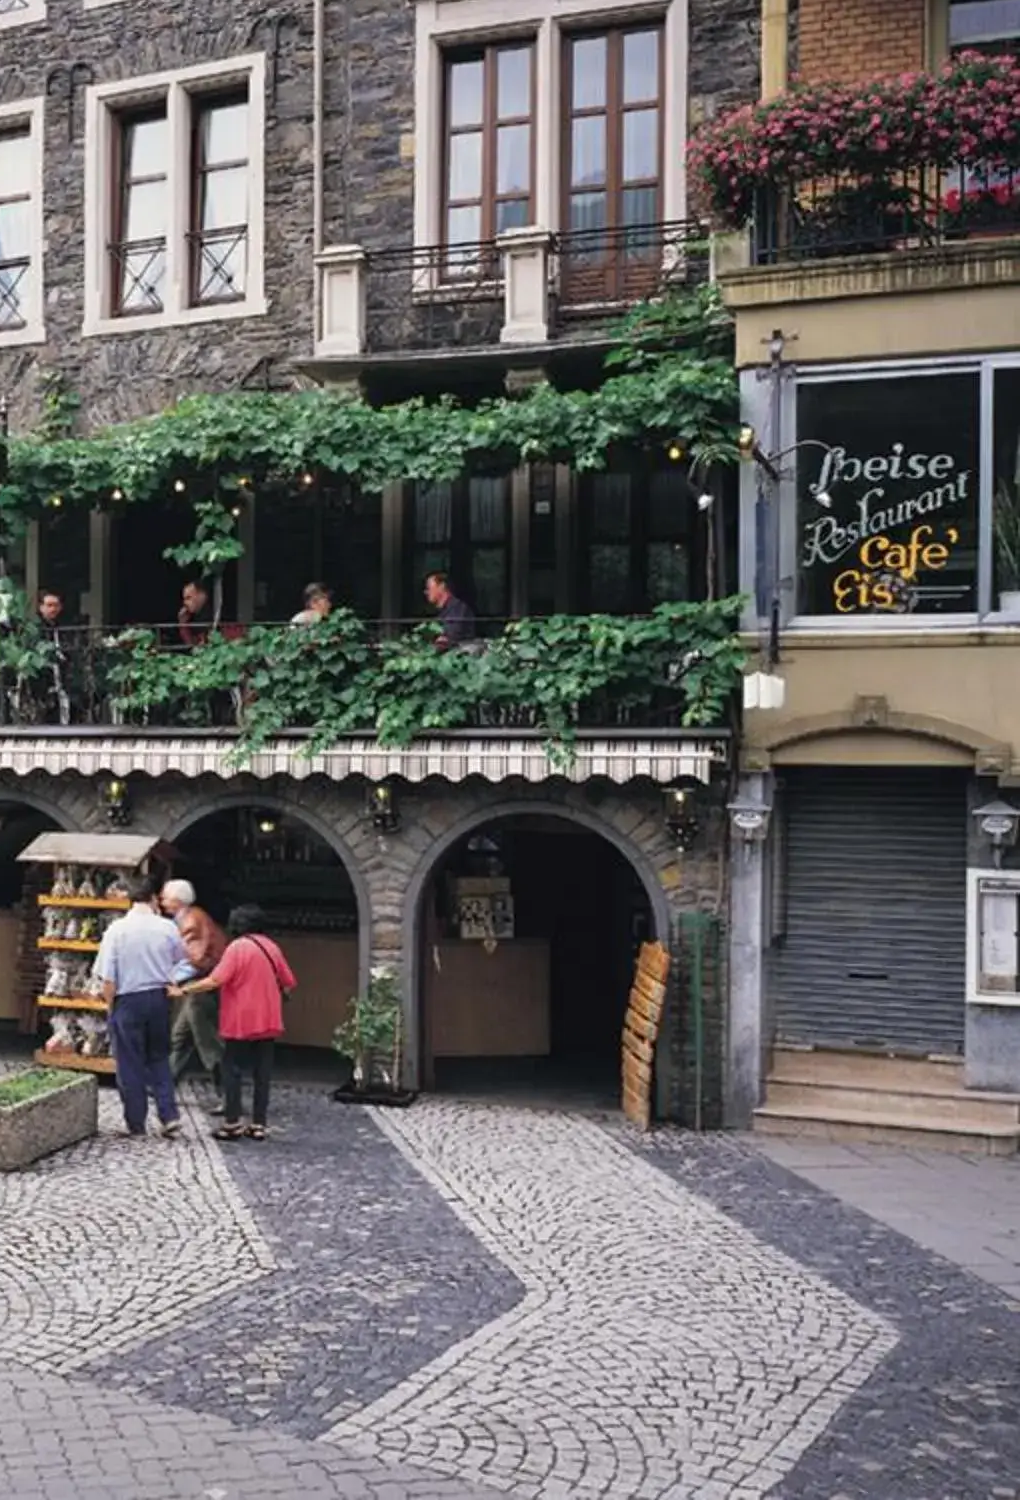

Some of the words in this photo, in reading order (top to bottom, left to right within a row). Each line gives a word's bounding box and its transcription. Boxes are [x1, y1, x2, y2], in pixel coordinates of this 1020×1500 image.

[809, 443, 955, 494] Speise
[802, 470, 972, 567] Restaurant
[833, 569, 894, 612] Eis
